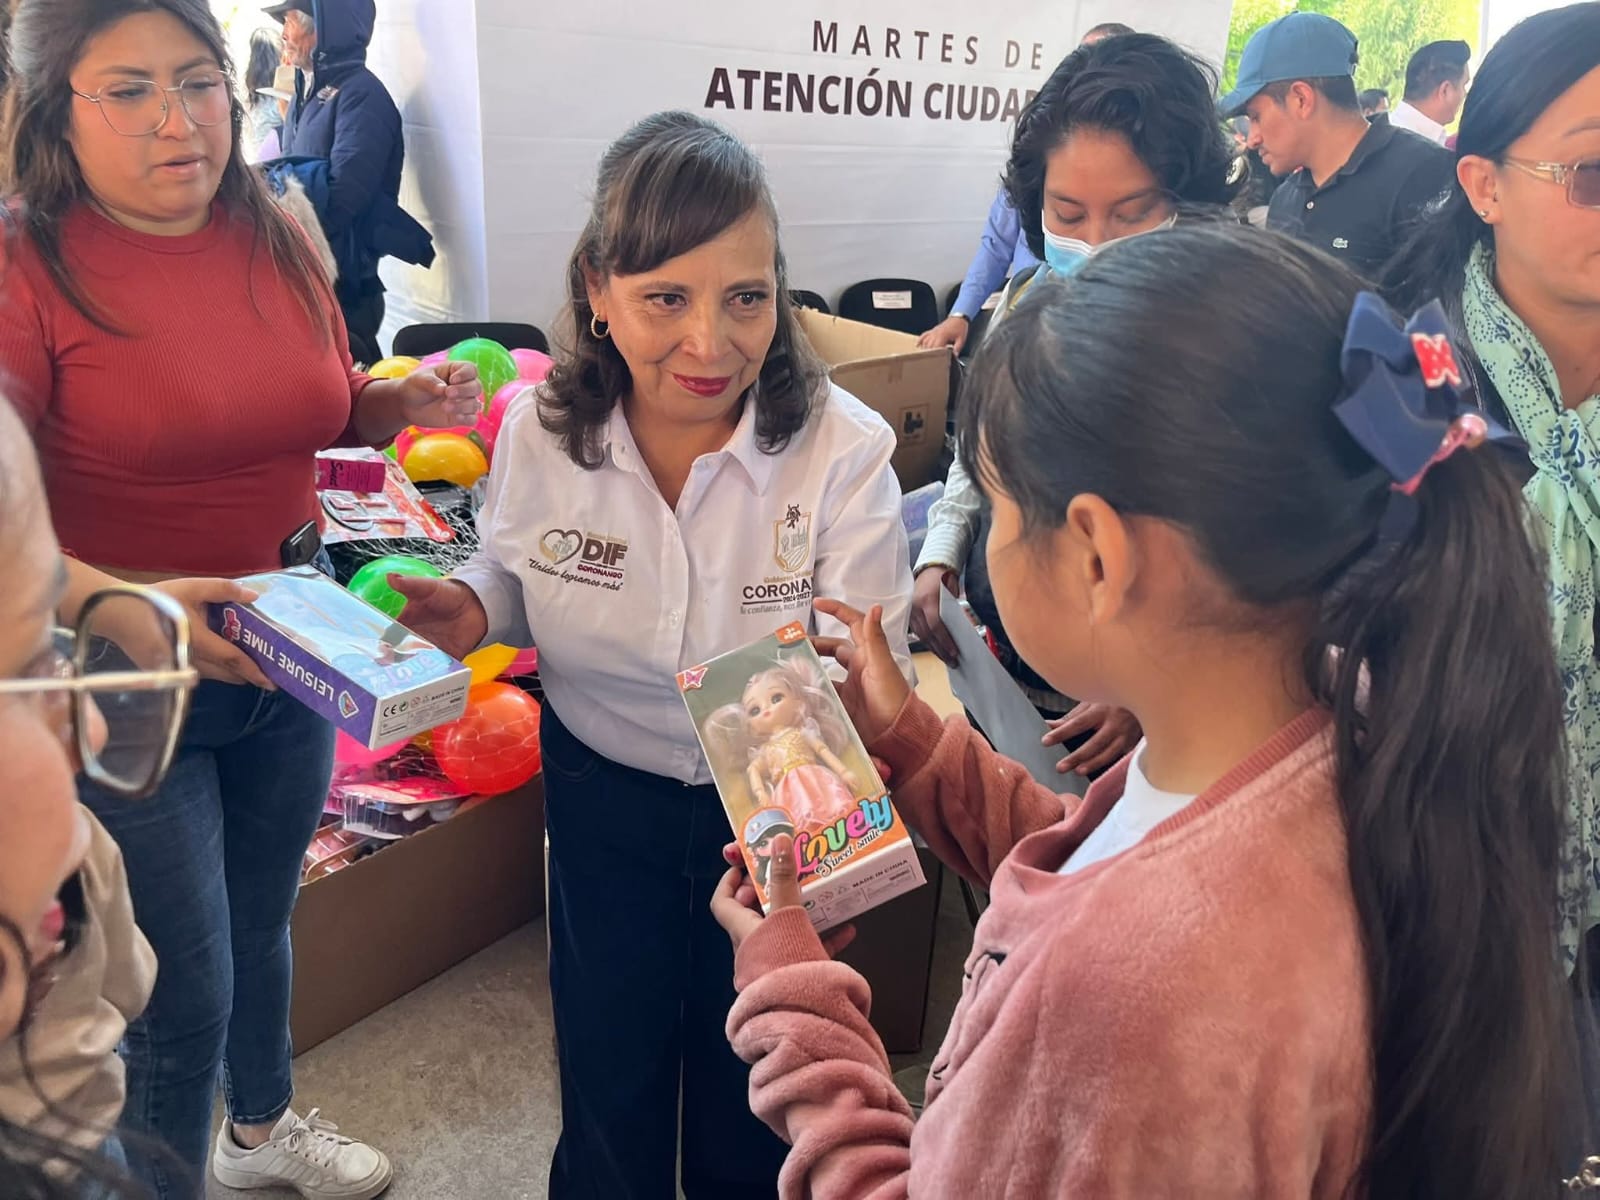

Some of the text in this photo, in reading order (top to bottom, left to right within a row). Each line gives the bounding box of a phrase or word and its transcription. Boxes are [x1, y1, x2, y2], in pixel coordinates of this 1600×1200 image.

[812, 20, 1043, 70] MARTES DE
[704, 68, 912, 118] ATENCIÓN
[577, 564, 623, 579] CORONANGO
[582, 538, 628, 566] DIF
[560, 569, 600, 587] logramos
[242, 628, 275, 661] TIME
[278, 652, 334, 701] LEISURE
[793, 794, 894, 881] Lovely
[815, 829, 881, 877] Sweet smile
